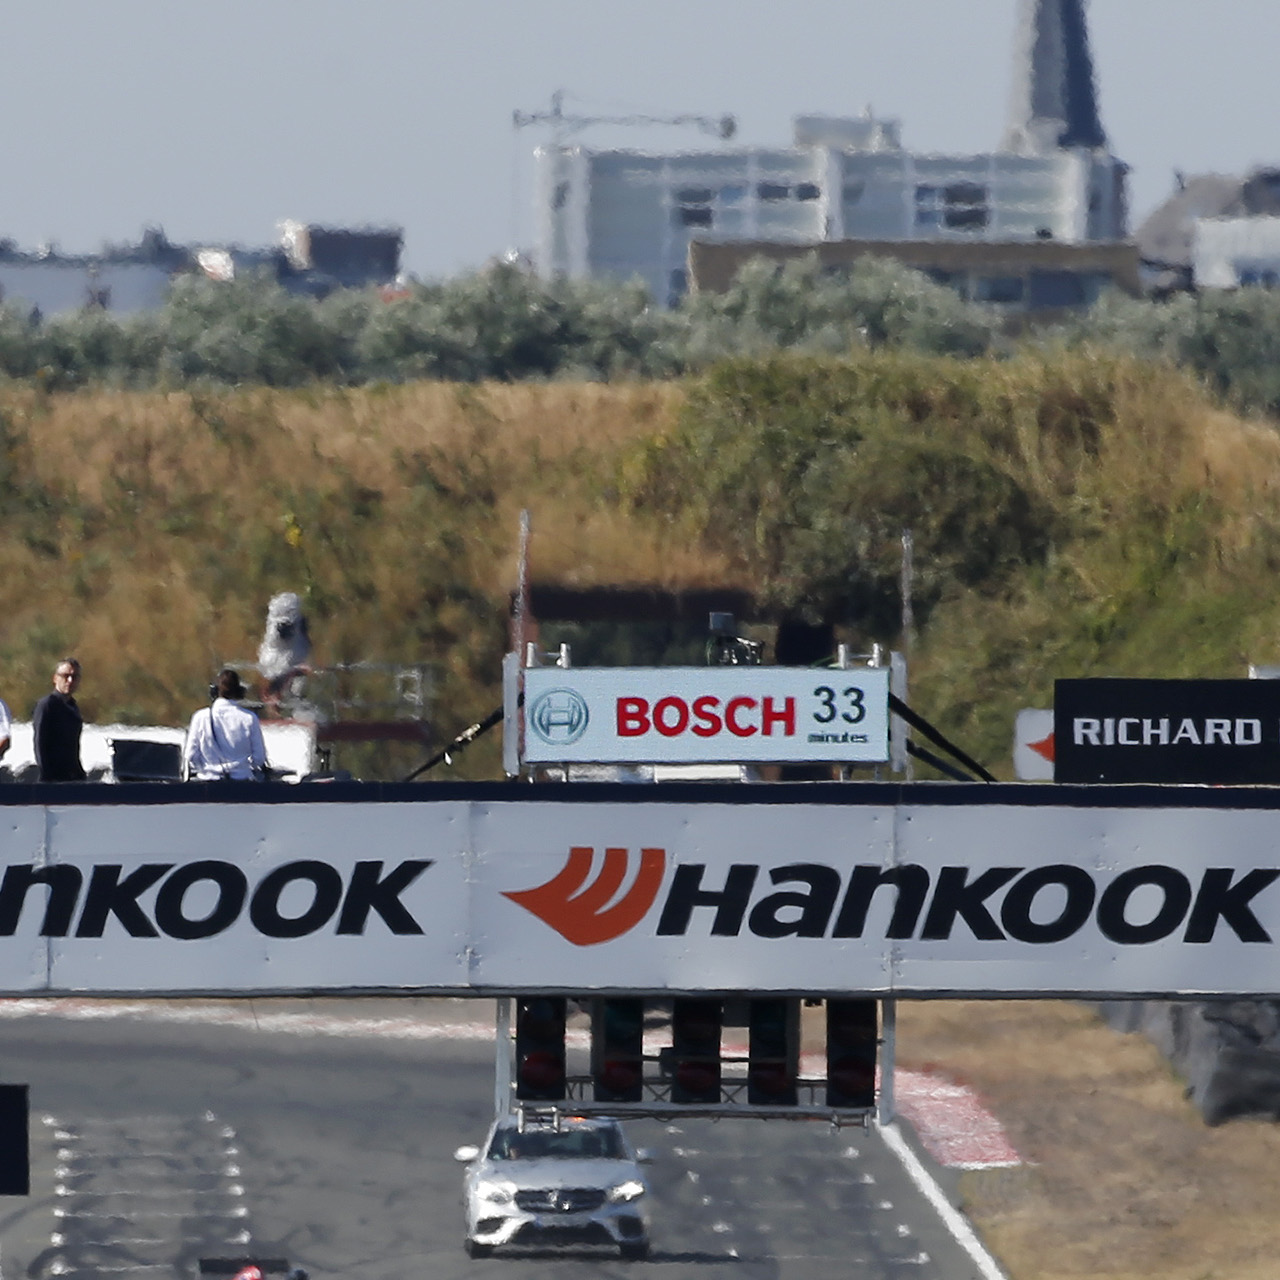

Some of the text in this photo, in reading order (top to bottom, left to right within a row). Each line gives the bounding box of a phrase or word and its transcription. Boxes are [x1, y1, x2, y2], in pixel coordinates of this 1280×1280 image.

[615, 686, 867, 738] BOSCH 33
[807, 732, 869, 744] minutes
[1072, 716, 1262, 747] RICHARD
